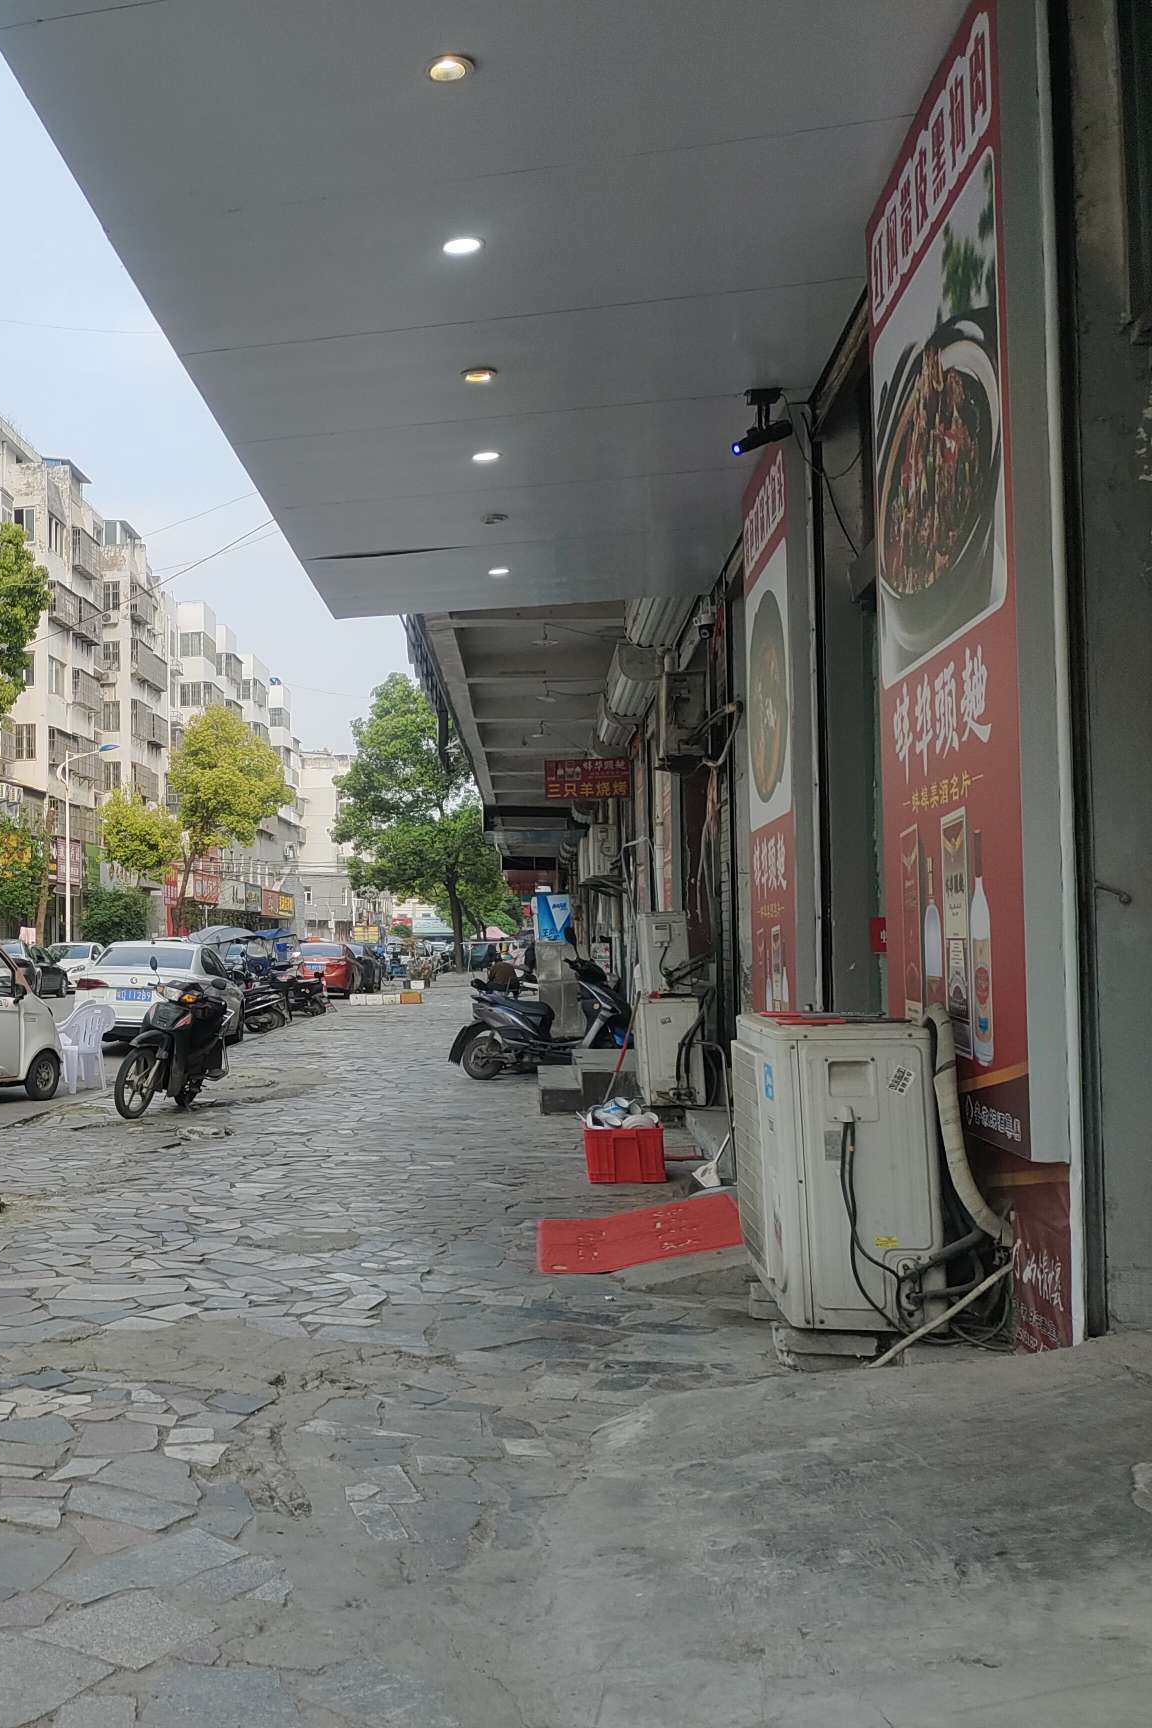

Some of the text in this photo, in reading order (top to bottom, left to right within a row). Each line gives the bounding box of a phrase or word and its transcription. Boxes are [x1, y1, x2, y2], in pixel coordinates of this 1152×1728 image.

[547, 781, 627, 798] 三只羊烧烤
